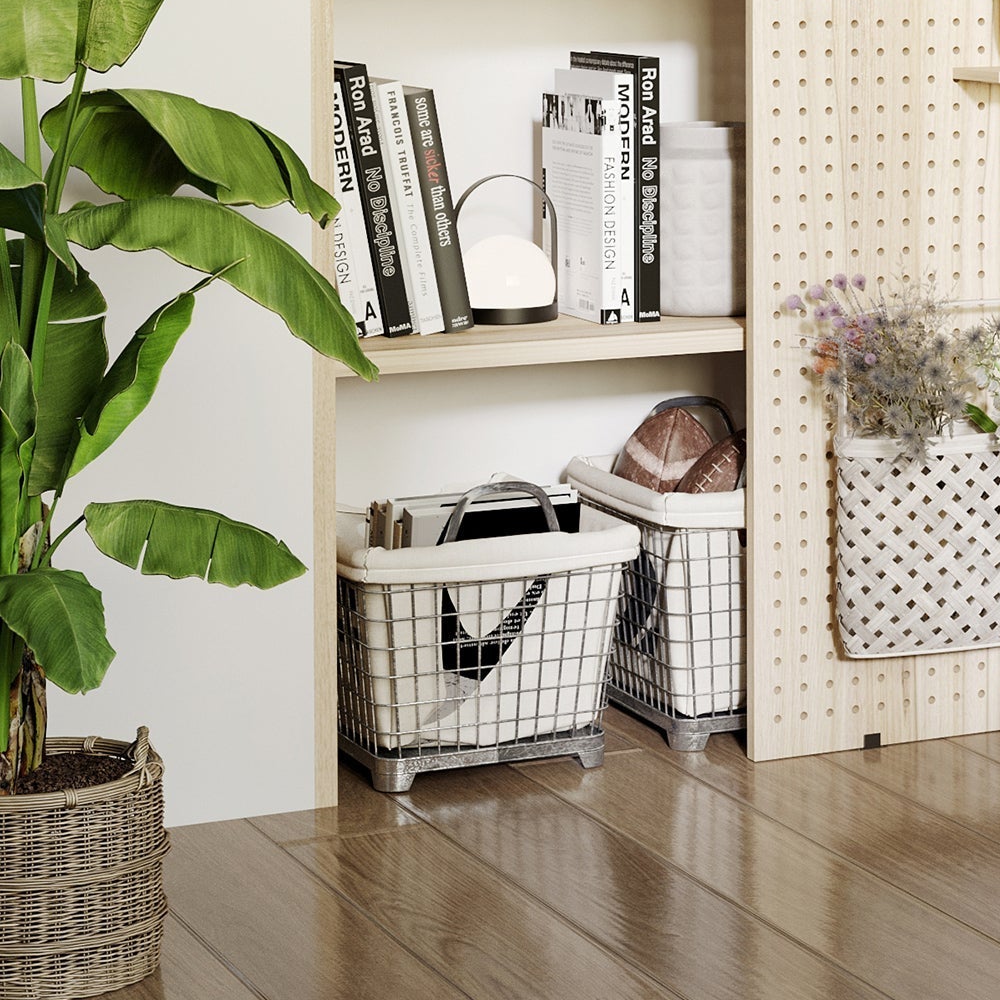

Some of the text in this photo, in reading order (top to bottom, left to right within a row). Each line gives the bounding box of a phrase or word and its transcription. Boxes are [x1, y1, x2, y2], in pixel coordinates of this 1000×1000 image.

[348, 76, 366, 112] Ron
[356, 117, 378, 157] Arad
[386, 91, 414, 198] FRANCOIS TRUFFAT
[618, 84, 630, 181] MODERN
[365, 166, 380, 192] No
[415, 96, 452, 248] some are sicker than others
[604, 156, 616, 216] FASHION
[640, 67, 658, 264] Ron Arad No Discipline
[370, 197, 396, 278] Discipline
[406, 203, 428, 297] The Complete Films
[603, 220, 616, 271] DESIGN
[365, 300, 378, 322] A
[388, 322, 412, 334] MoMA
[639, 310, 660, 320] MoMA
